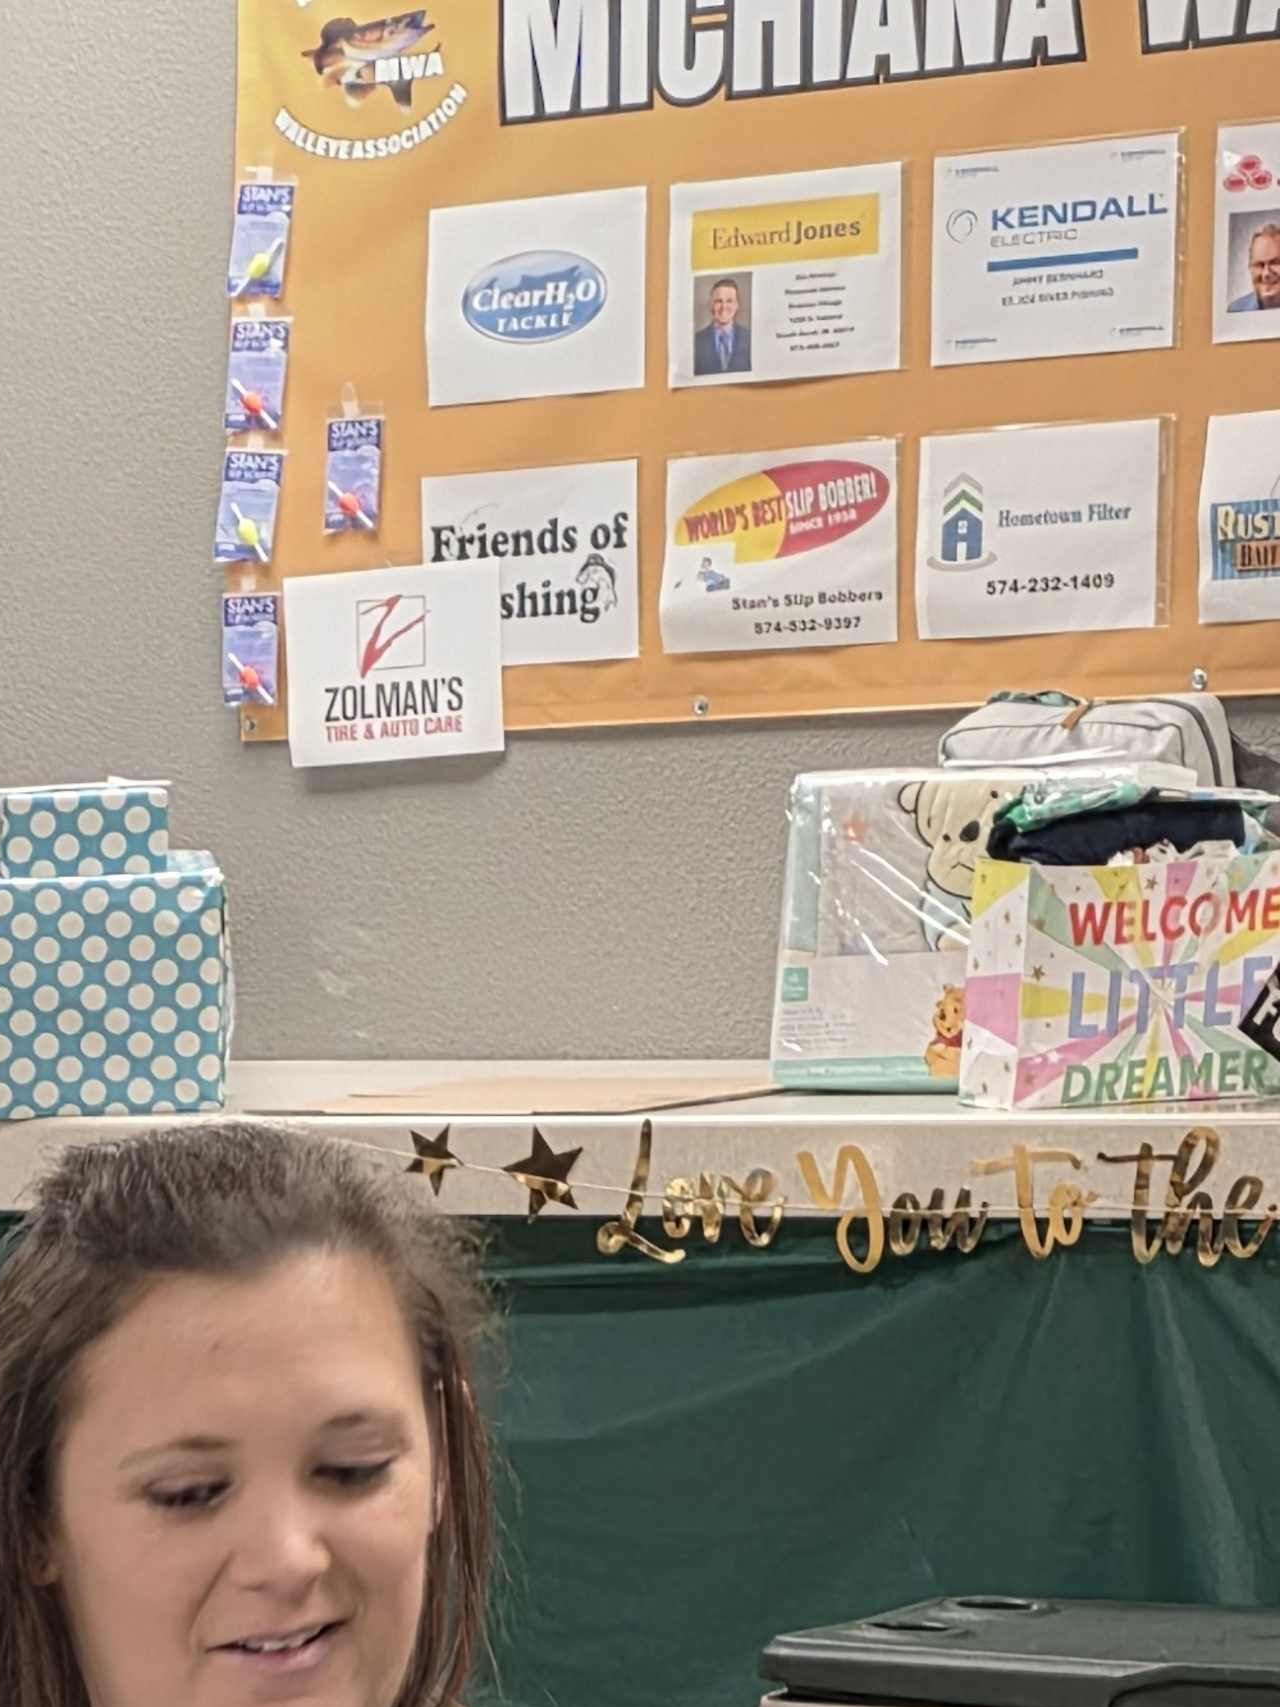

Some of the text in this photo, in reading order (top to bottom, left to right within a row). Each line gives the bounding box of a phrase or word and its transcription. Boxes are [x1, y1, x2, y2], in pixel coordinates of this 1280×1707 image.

[374, 52, 444, 83] MWA
[991, 193, 1168, 231] KENDALL
[712, 219, 861, 250] Edward Jones
[990, 229, 1078, 248] ELECTRIC
[496, 312, 573, 333] TACKLE
[752, 496, 784, 529] BEST
[785, 487, 814, 519] SLIP
[998, 503, 1132, 528] Hometown Filter
[431, 512, 629, 563] Friends of
[500, 580, 600, 623] shing
[986, 573, 1115, 596] 574-232-1409
[325, 676, 464, 723] ZOLMAN'S
[326, 714, 464, 743] TIRE & AUTO CARE
[1069, 886, 1280, 947] WELCOME
[1060, 1050, 1269, 1104] DREAMER
[597, 1119, 787, 1264] Love
[797, 1143, 990, 1275] You
